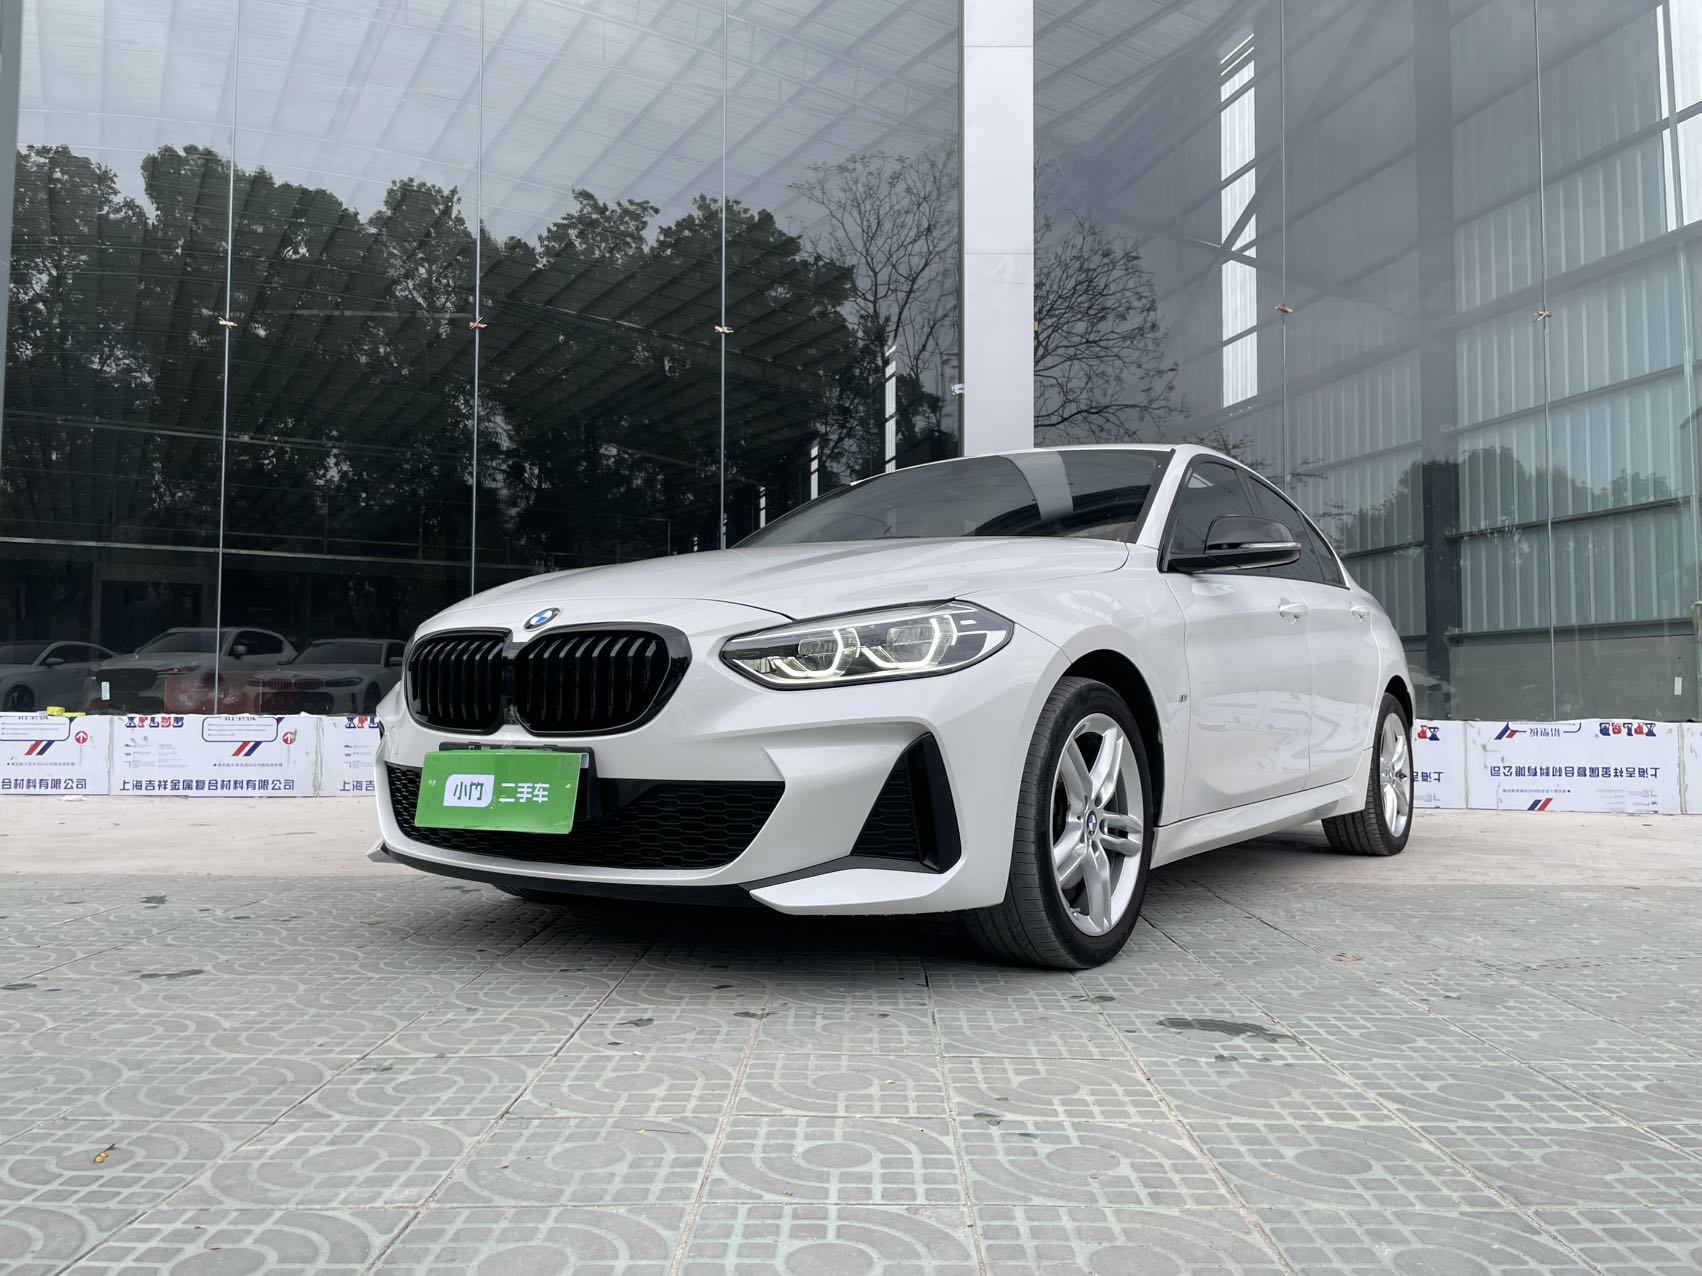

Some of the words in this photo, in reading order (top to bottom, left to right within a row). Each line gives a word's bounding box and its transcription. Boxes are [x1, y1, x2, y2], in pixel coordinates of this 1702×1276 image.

[1490, 765, 1660, 779] 上海吉祥金属复合材料有限公司
[1, 777, 87, 790] 合材料有限公司
[119, 779, 295, 792] 上海吉祥金属复合材料有限公司
[498, 782, 550, 803] 二手车
